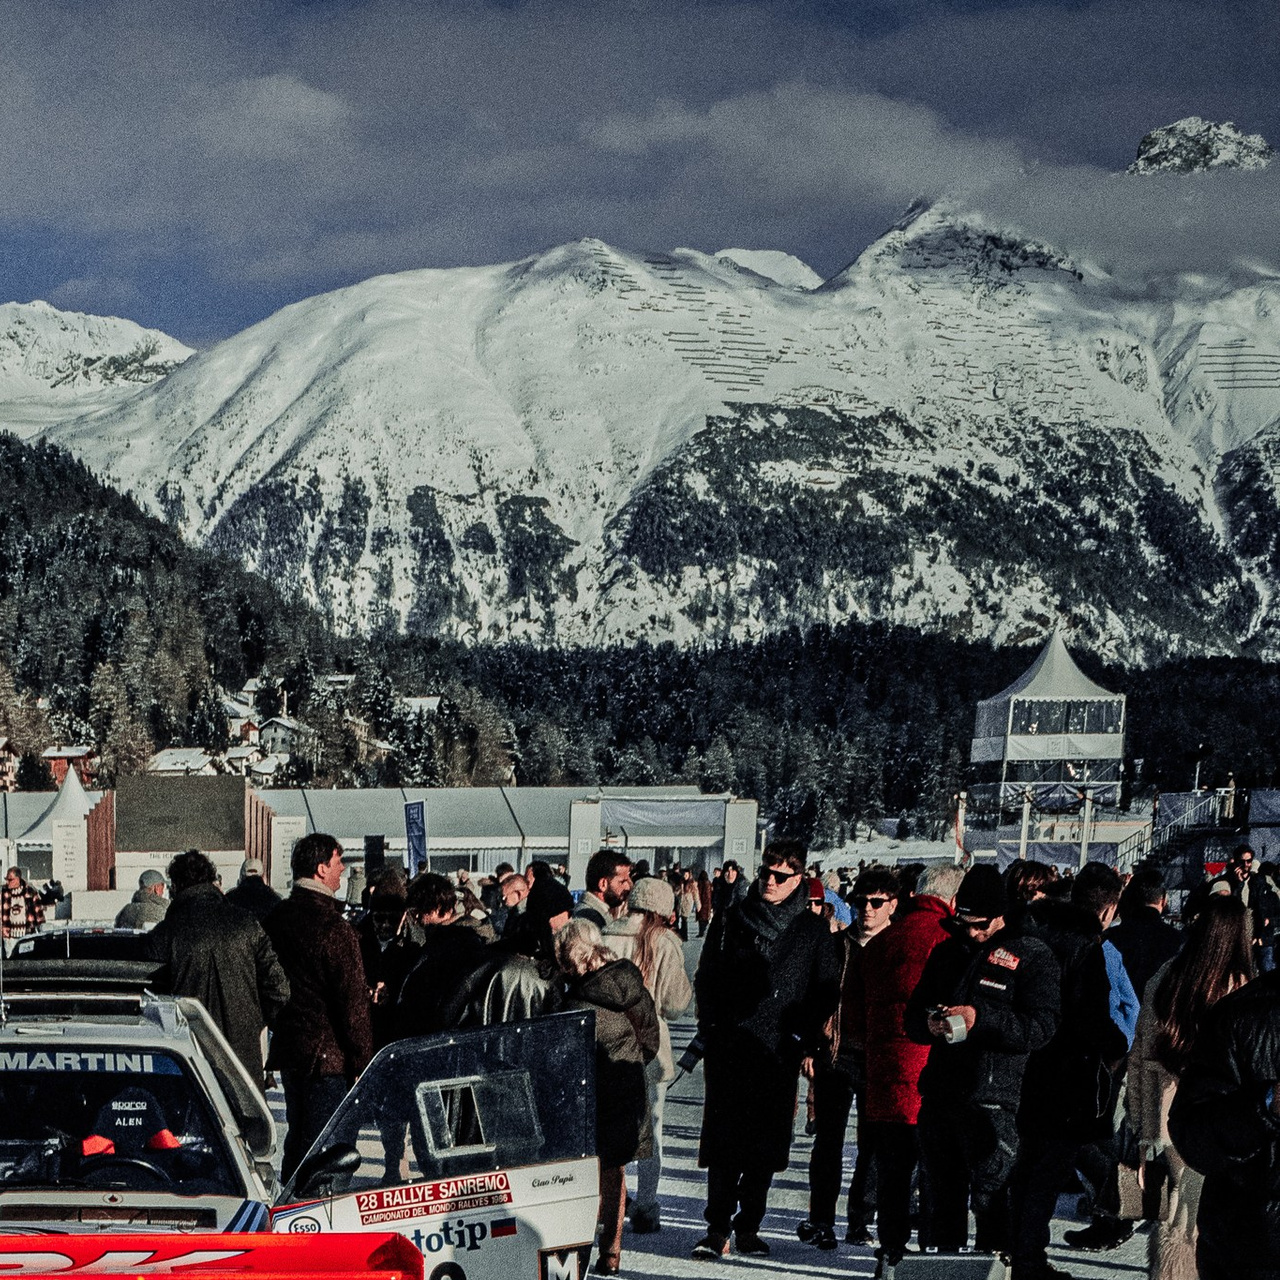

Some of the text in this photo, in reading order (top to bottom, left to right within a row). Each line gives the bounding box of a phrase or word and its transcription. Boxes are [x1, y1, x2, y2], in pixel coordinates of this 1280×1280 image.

[115, 1117, 143, 1126] ALEN
[360, 1173, 508, 1211] 28 RALLYE SANREMO
[531, 1177, 550, 1188] Ciao
[362, 1210, 410, 1225] CAMPIONATO
[412, 1207, 427, 1217] DEL
[428, 1202, 457, 1214] MONDO
[458, 1197, 489, 1210] RALLYES
